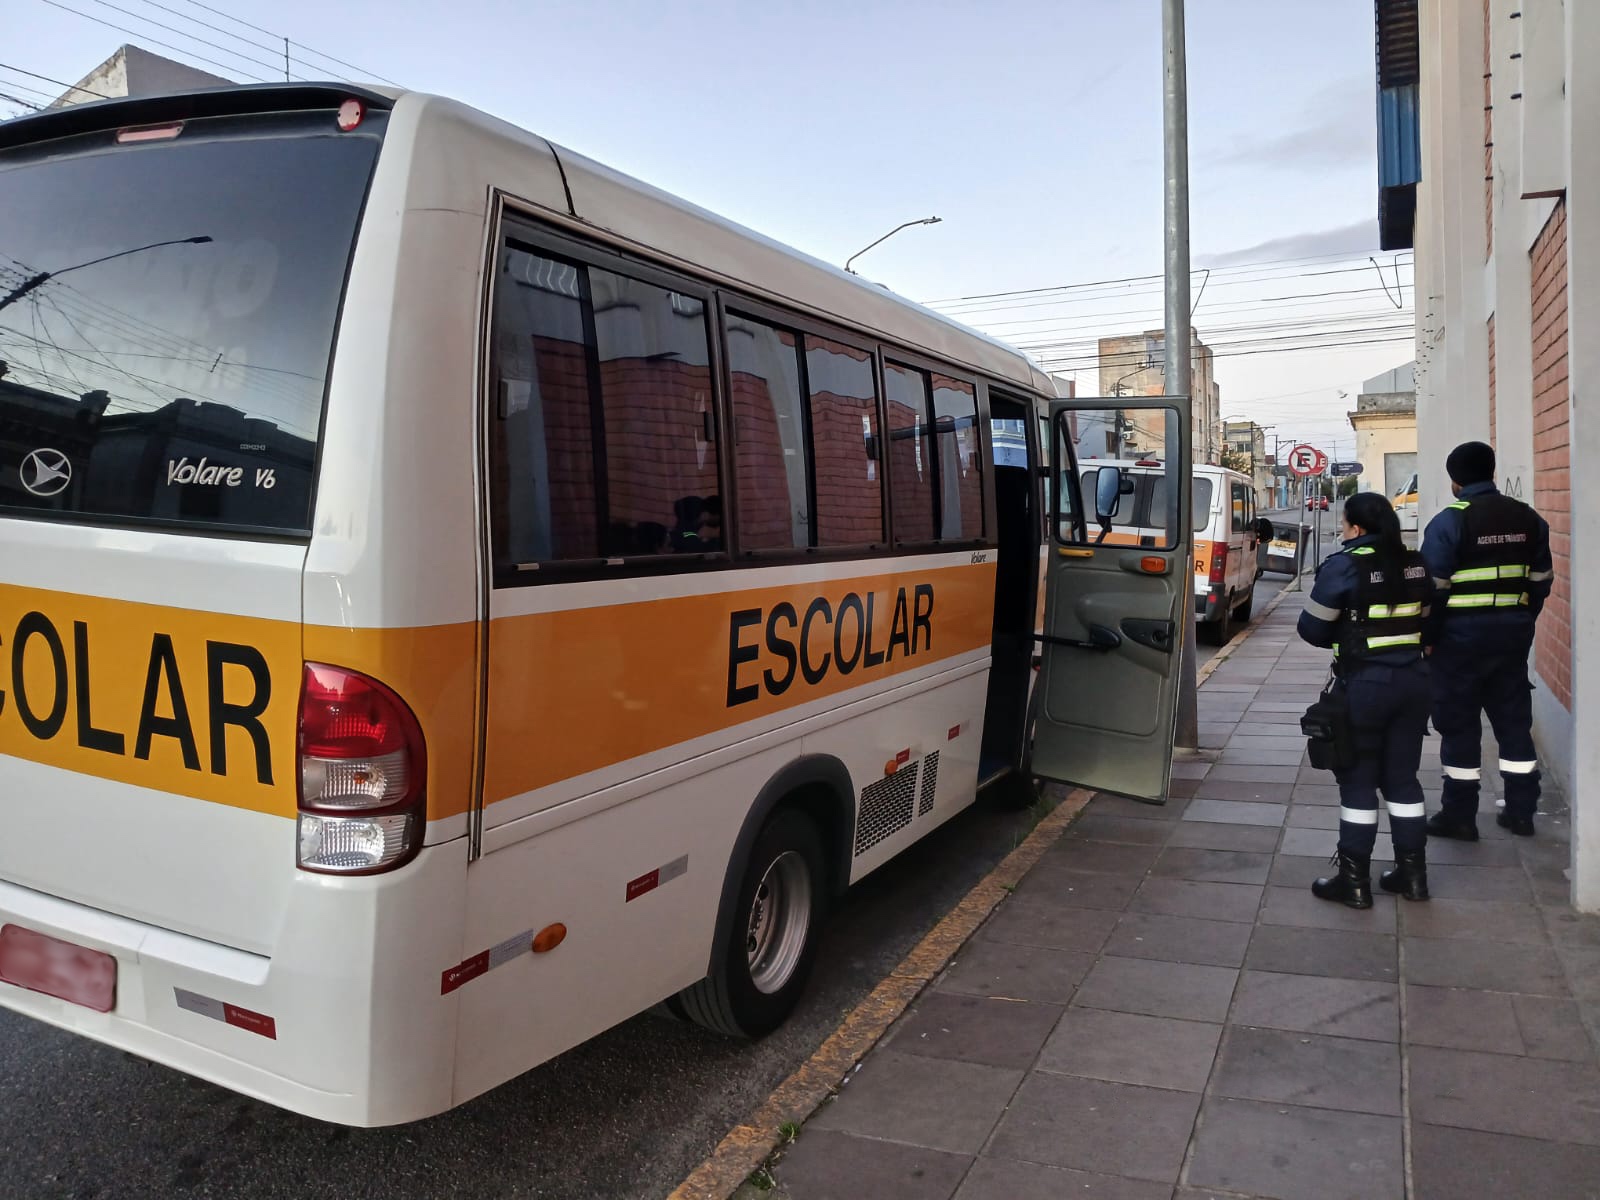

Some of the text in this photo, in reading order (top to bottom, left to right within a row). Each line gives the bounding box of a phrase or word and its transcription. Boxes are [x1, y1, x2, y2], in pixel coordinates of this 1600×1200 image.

[167, 457, 276, 489] Volare V6
[1296, 452, 1311, 468] E
[1477, 535, 1497, 545] AGENTE
[1497, 534, 1505, 544] DE
[726, 583, 934, 708] ESCOLAR
[0, 610, 275, 786] OLAR
